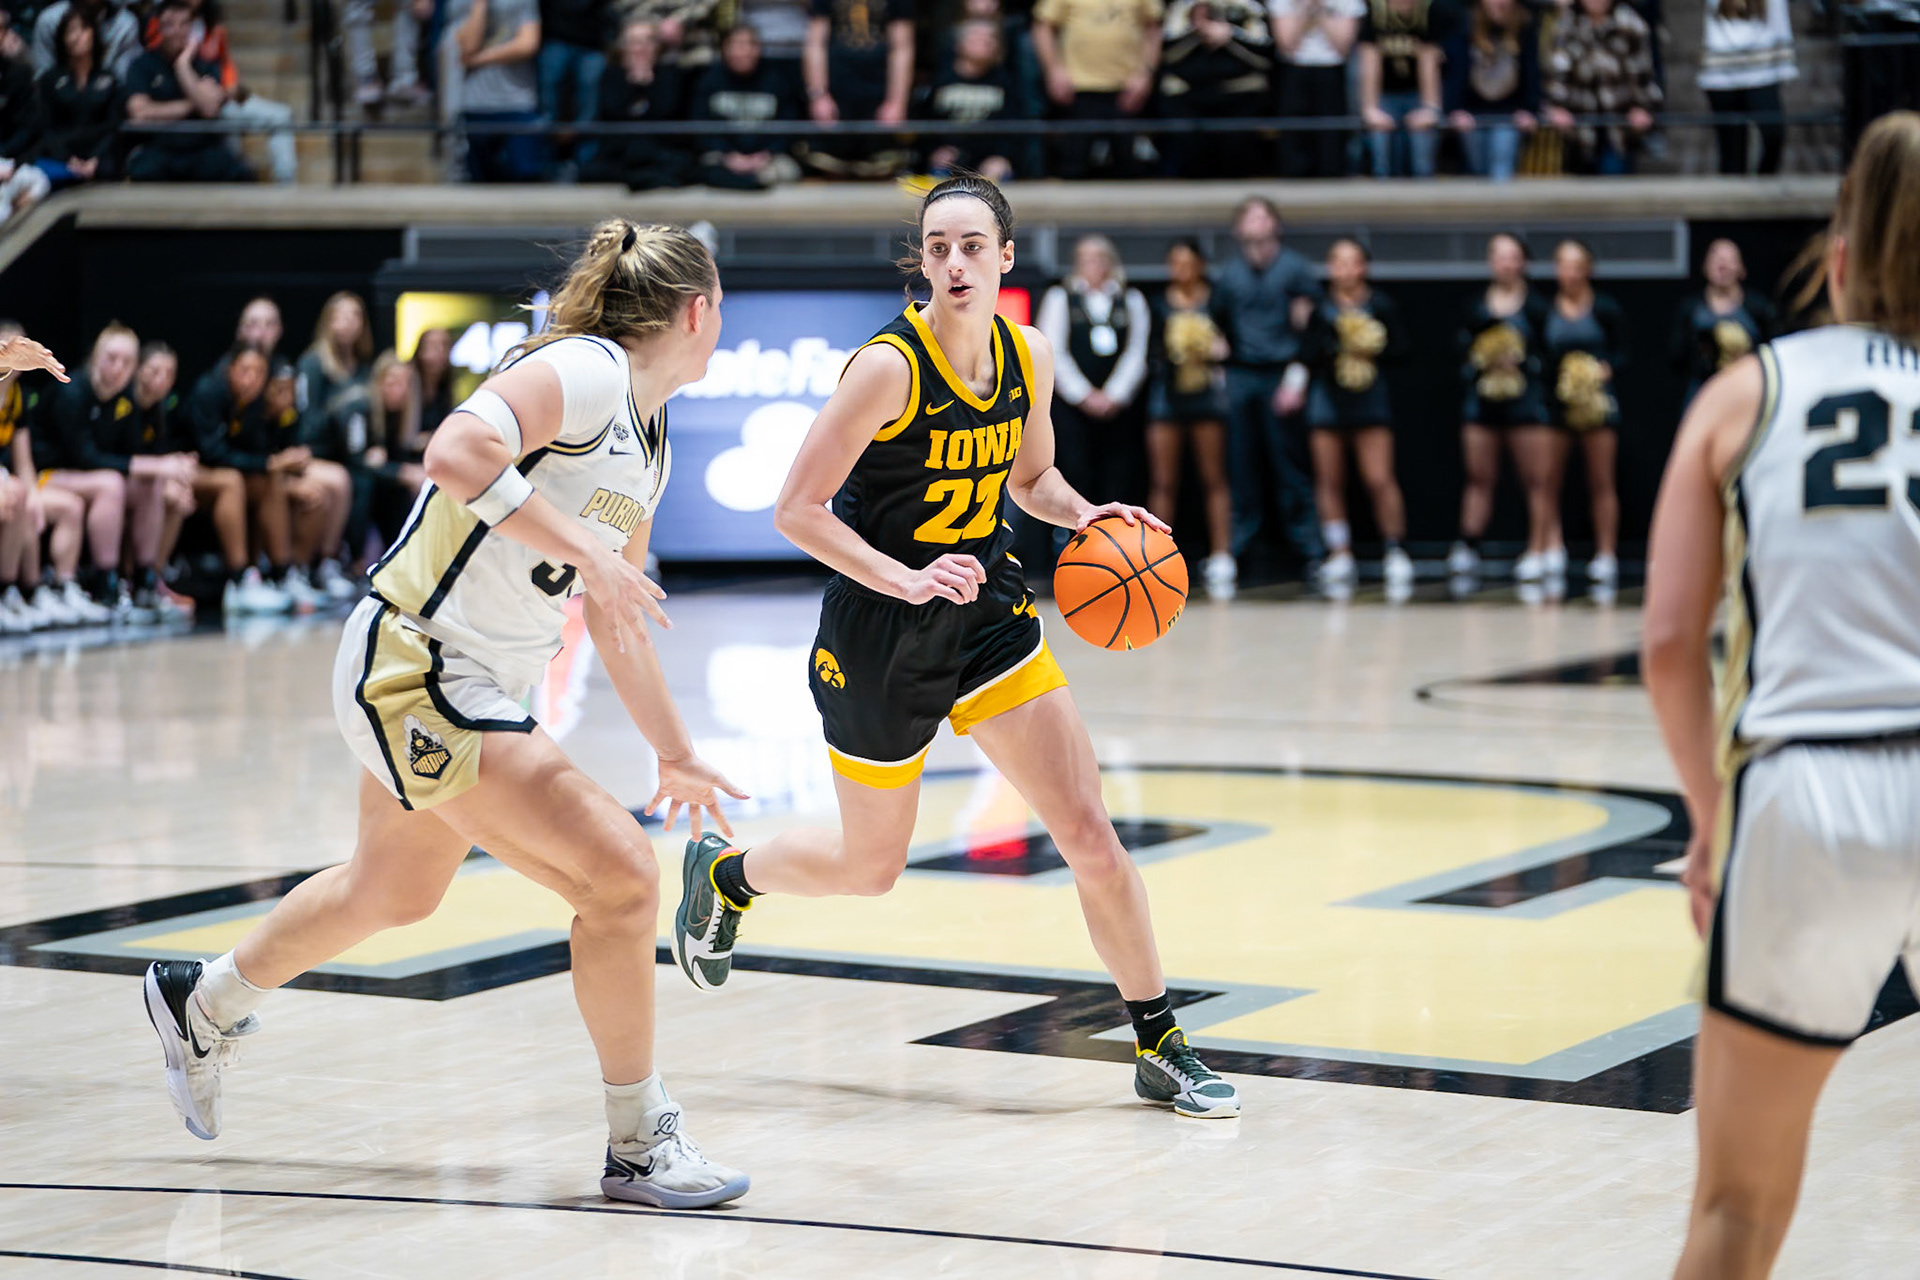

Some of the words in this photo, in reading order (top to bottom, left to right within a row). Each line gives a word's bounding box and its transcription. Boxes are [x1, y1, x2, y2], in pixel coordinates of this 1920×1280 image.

[924, 416, 1023, 470] IOWA
[913, 469, 1009, 545] 22
[412, 750, 450, 775] PURDUE
